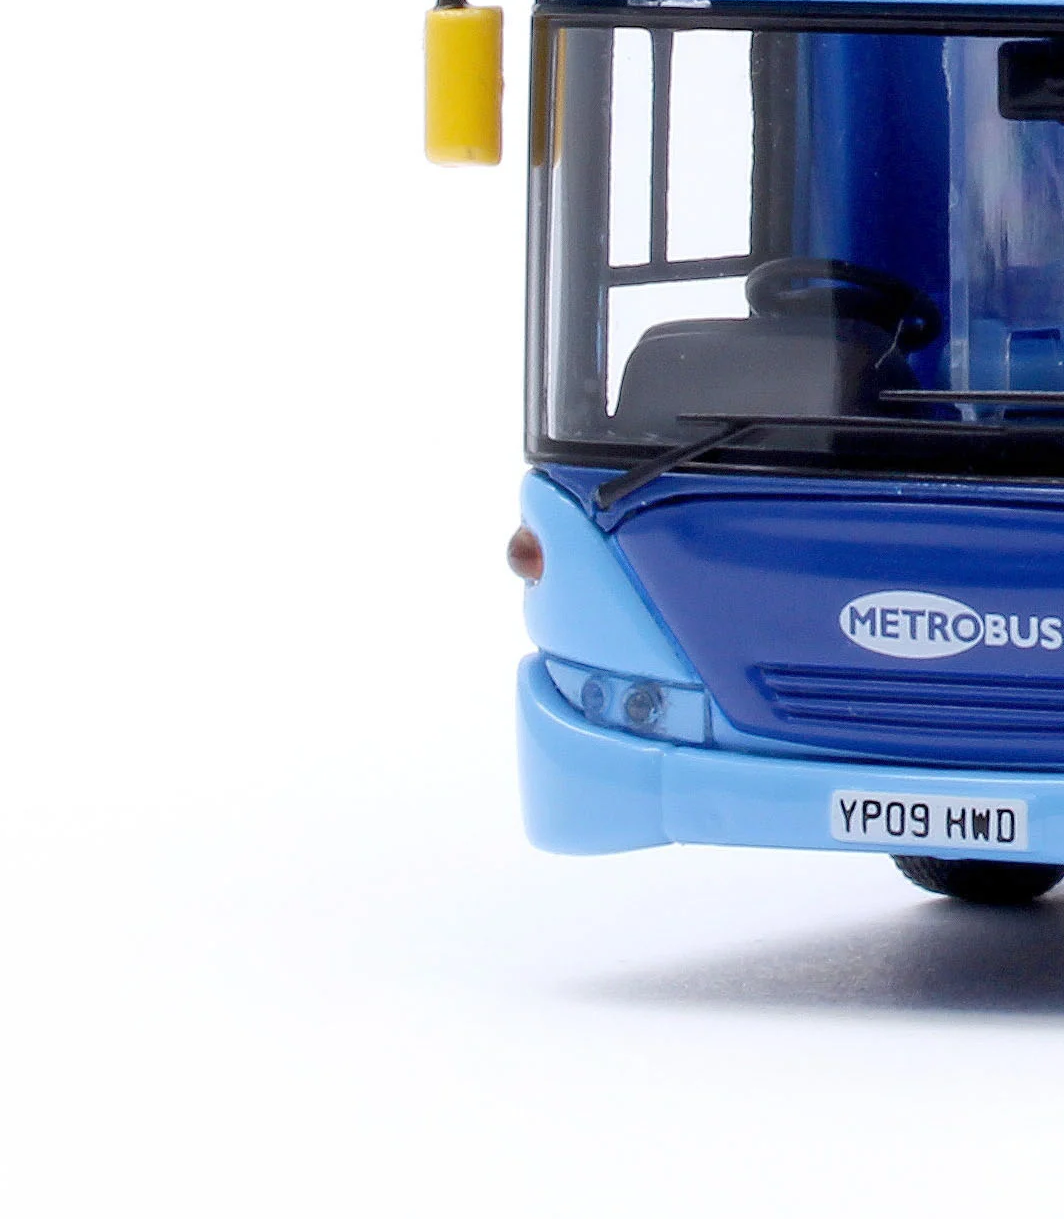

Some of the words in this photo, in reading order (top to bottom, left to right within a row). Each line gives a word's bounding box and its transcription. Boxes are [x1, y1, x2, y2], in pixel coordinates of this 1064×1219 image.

[849, 605, 1063, 650] METROBUS
[840, 799, 930, 838] YP09
[946, 807, 1015, 843] HWD
